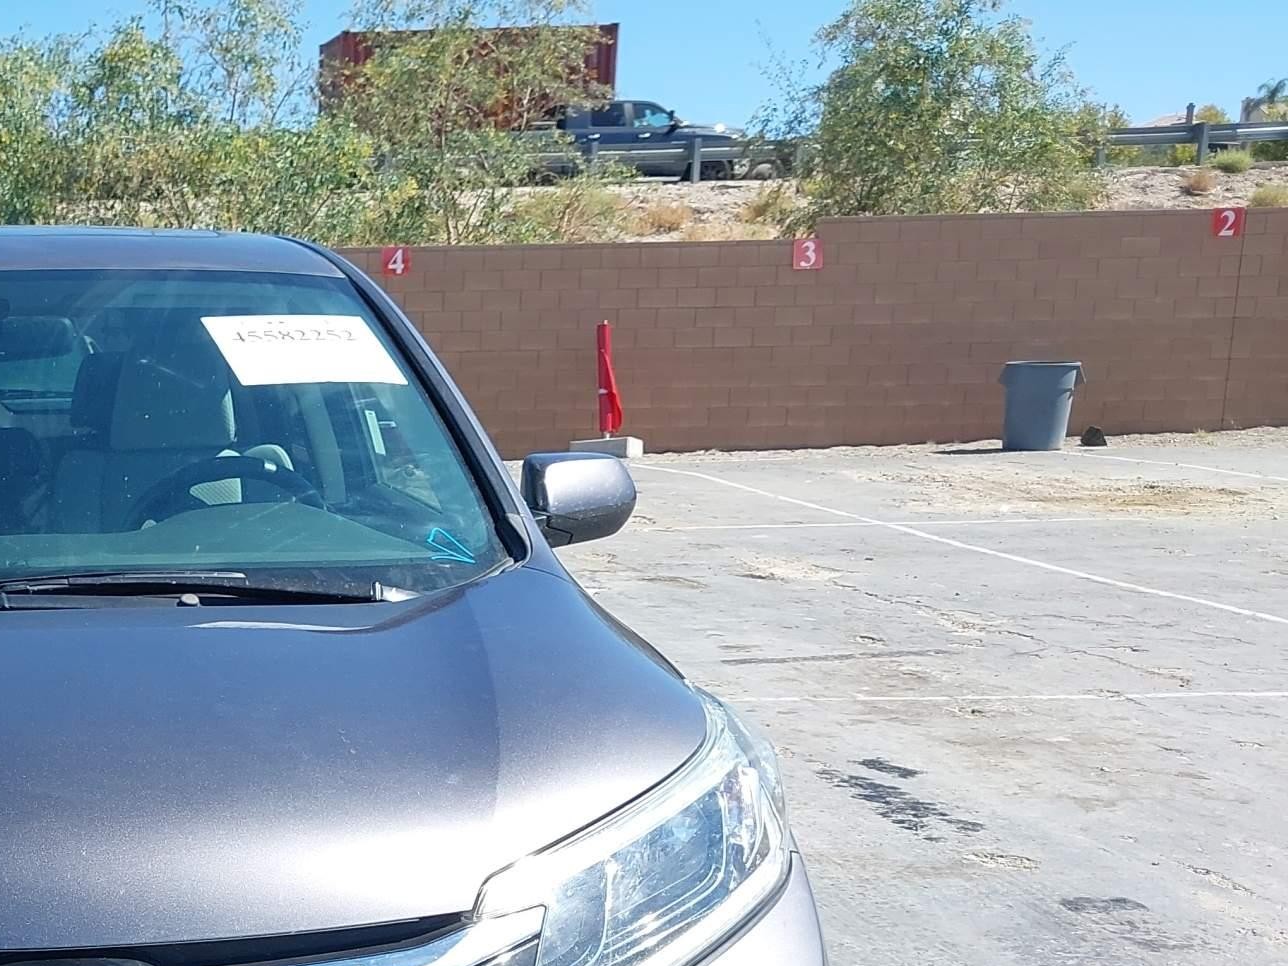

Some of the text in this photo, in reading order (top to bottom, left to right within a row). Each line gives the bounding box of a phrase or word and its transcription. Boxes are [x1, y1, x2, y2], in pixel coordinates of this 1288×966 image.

[1218, 210, 1235, 236] 2
[388, 249, 404, 274] 4
[800, 241, 816, 266] 3
